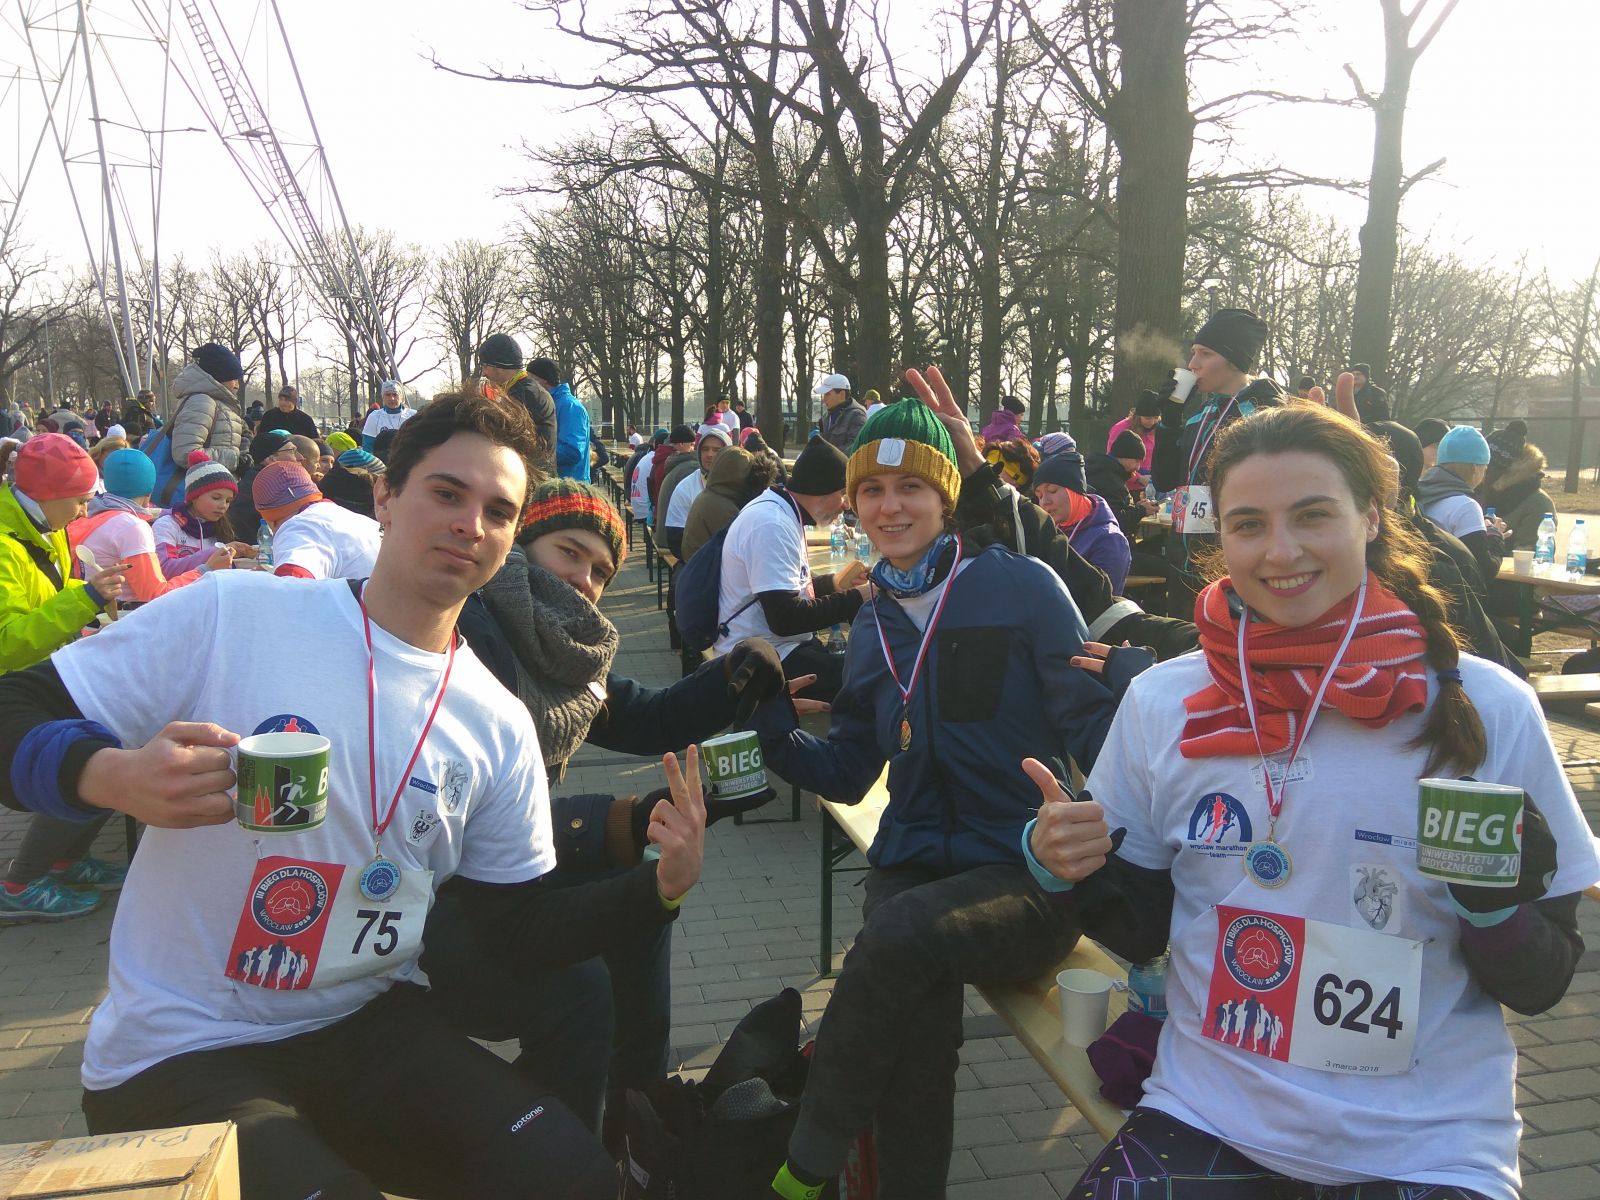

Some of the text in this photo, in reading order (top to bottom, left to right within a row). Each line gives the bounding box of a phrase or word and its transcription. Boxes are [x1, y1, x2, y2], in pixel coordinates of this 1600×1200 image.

[1191, 501, 1208, 519] 45
[718, 747, 760, 777] BIEG
[1423, 807, 1506, 846] BIEG
[1209, 851, 1227, 859] team
[1215, 844, 1248, 852] marathon
[1421, 846, 1496, 866] UNIWERSYTETU
[1420, 856, 1484, 874] MEDYCZNEGO
[255, 890, 265, 899] III
[260, 873, 280, 891] BIEG
[279, 868, 299, 879] DLA
[294, 914, 312, 929] 2018
[1228, 921, 1244, 939] BIEG
[1242, 917, 1260, 926] DLA
[351, 909, 402, 957] 75
[1265, 971, 1281, 985] 2018
[1313, 972, 1404, 1040] 624
[1325, 1060, 1380, 1073] 3 marca 2018
[511, 1105, 545, 1132] aptonia
